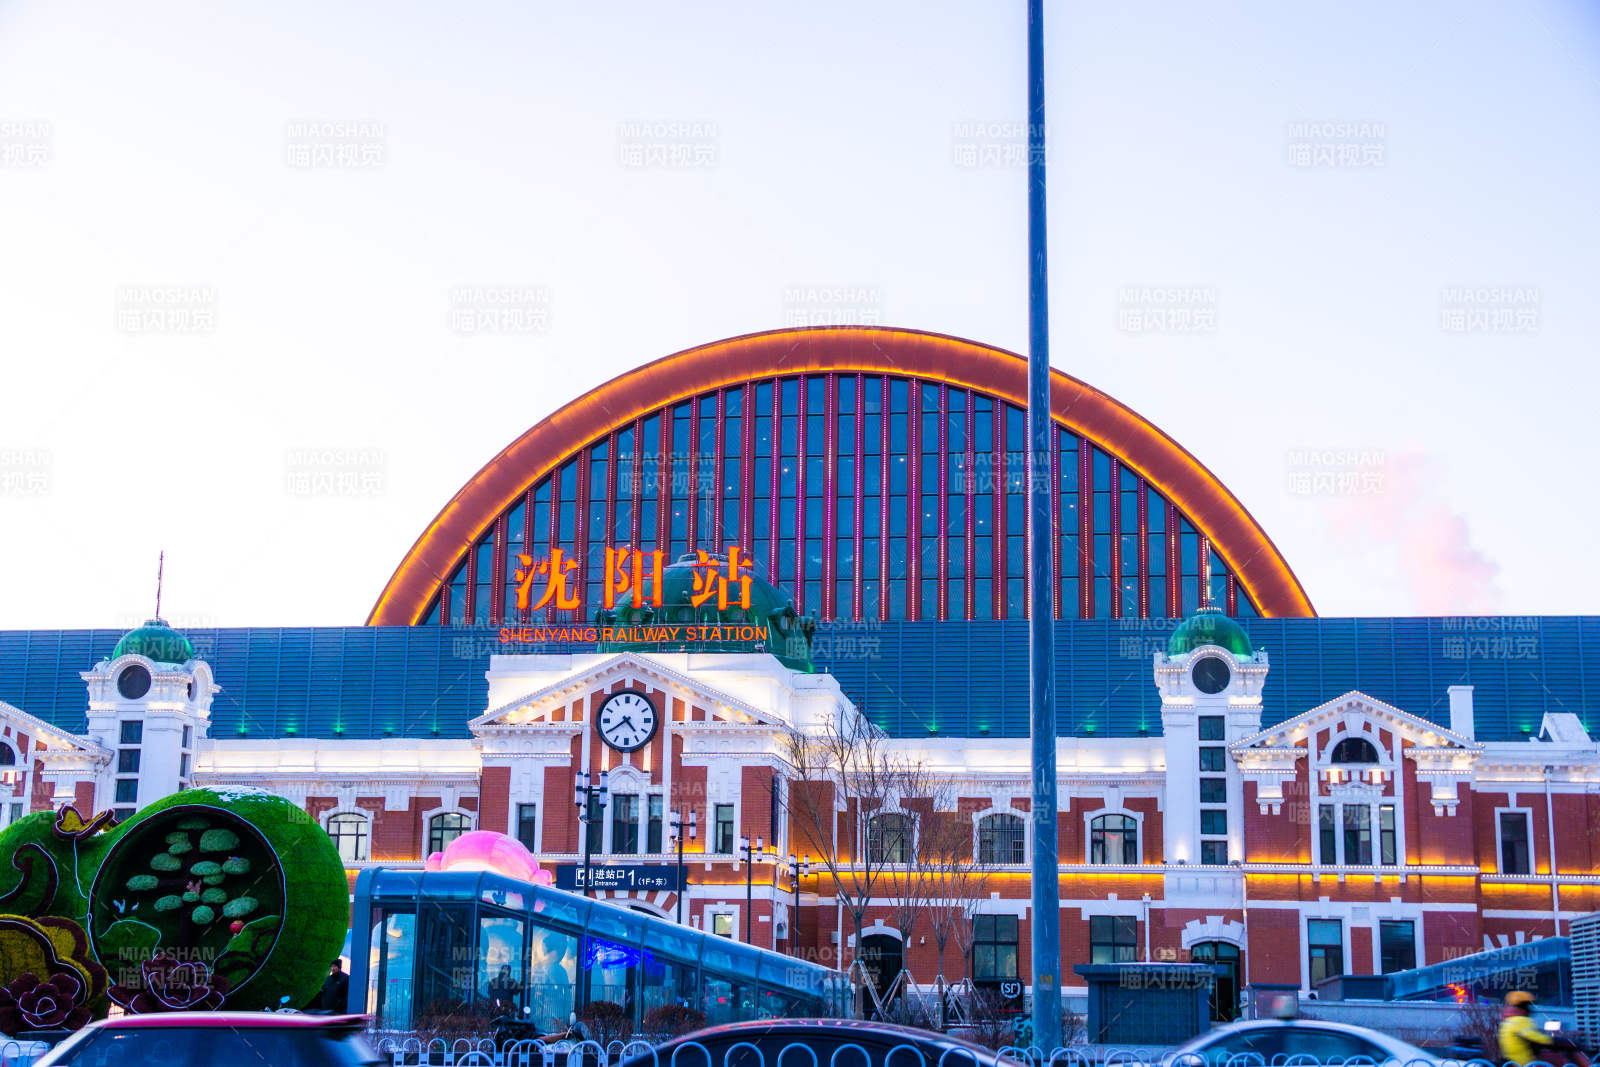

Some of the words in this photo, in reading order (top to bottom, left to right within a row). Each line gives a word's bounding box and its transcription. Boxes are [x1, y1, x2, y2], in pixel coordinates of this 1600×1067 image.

[515, 546, 754, 611] 沈阳站
[499, 627, 597, 643] SHENYANG
[602, 627, 681, 642] RAILWAY
[685, 626, 768, 641] STATION
[595, 869, 625, 880] 进站口
[628, 869, 636, 886] 1
